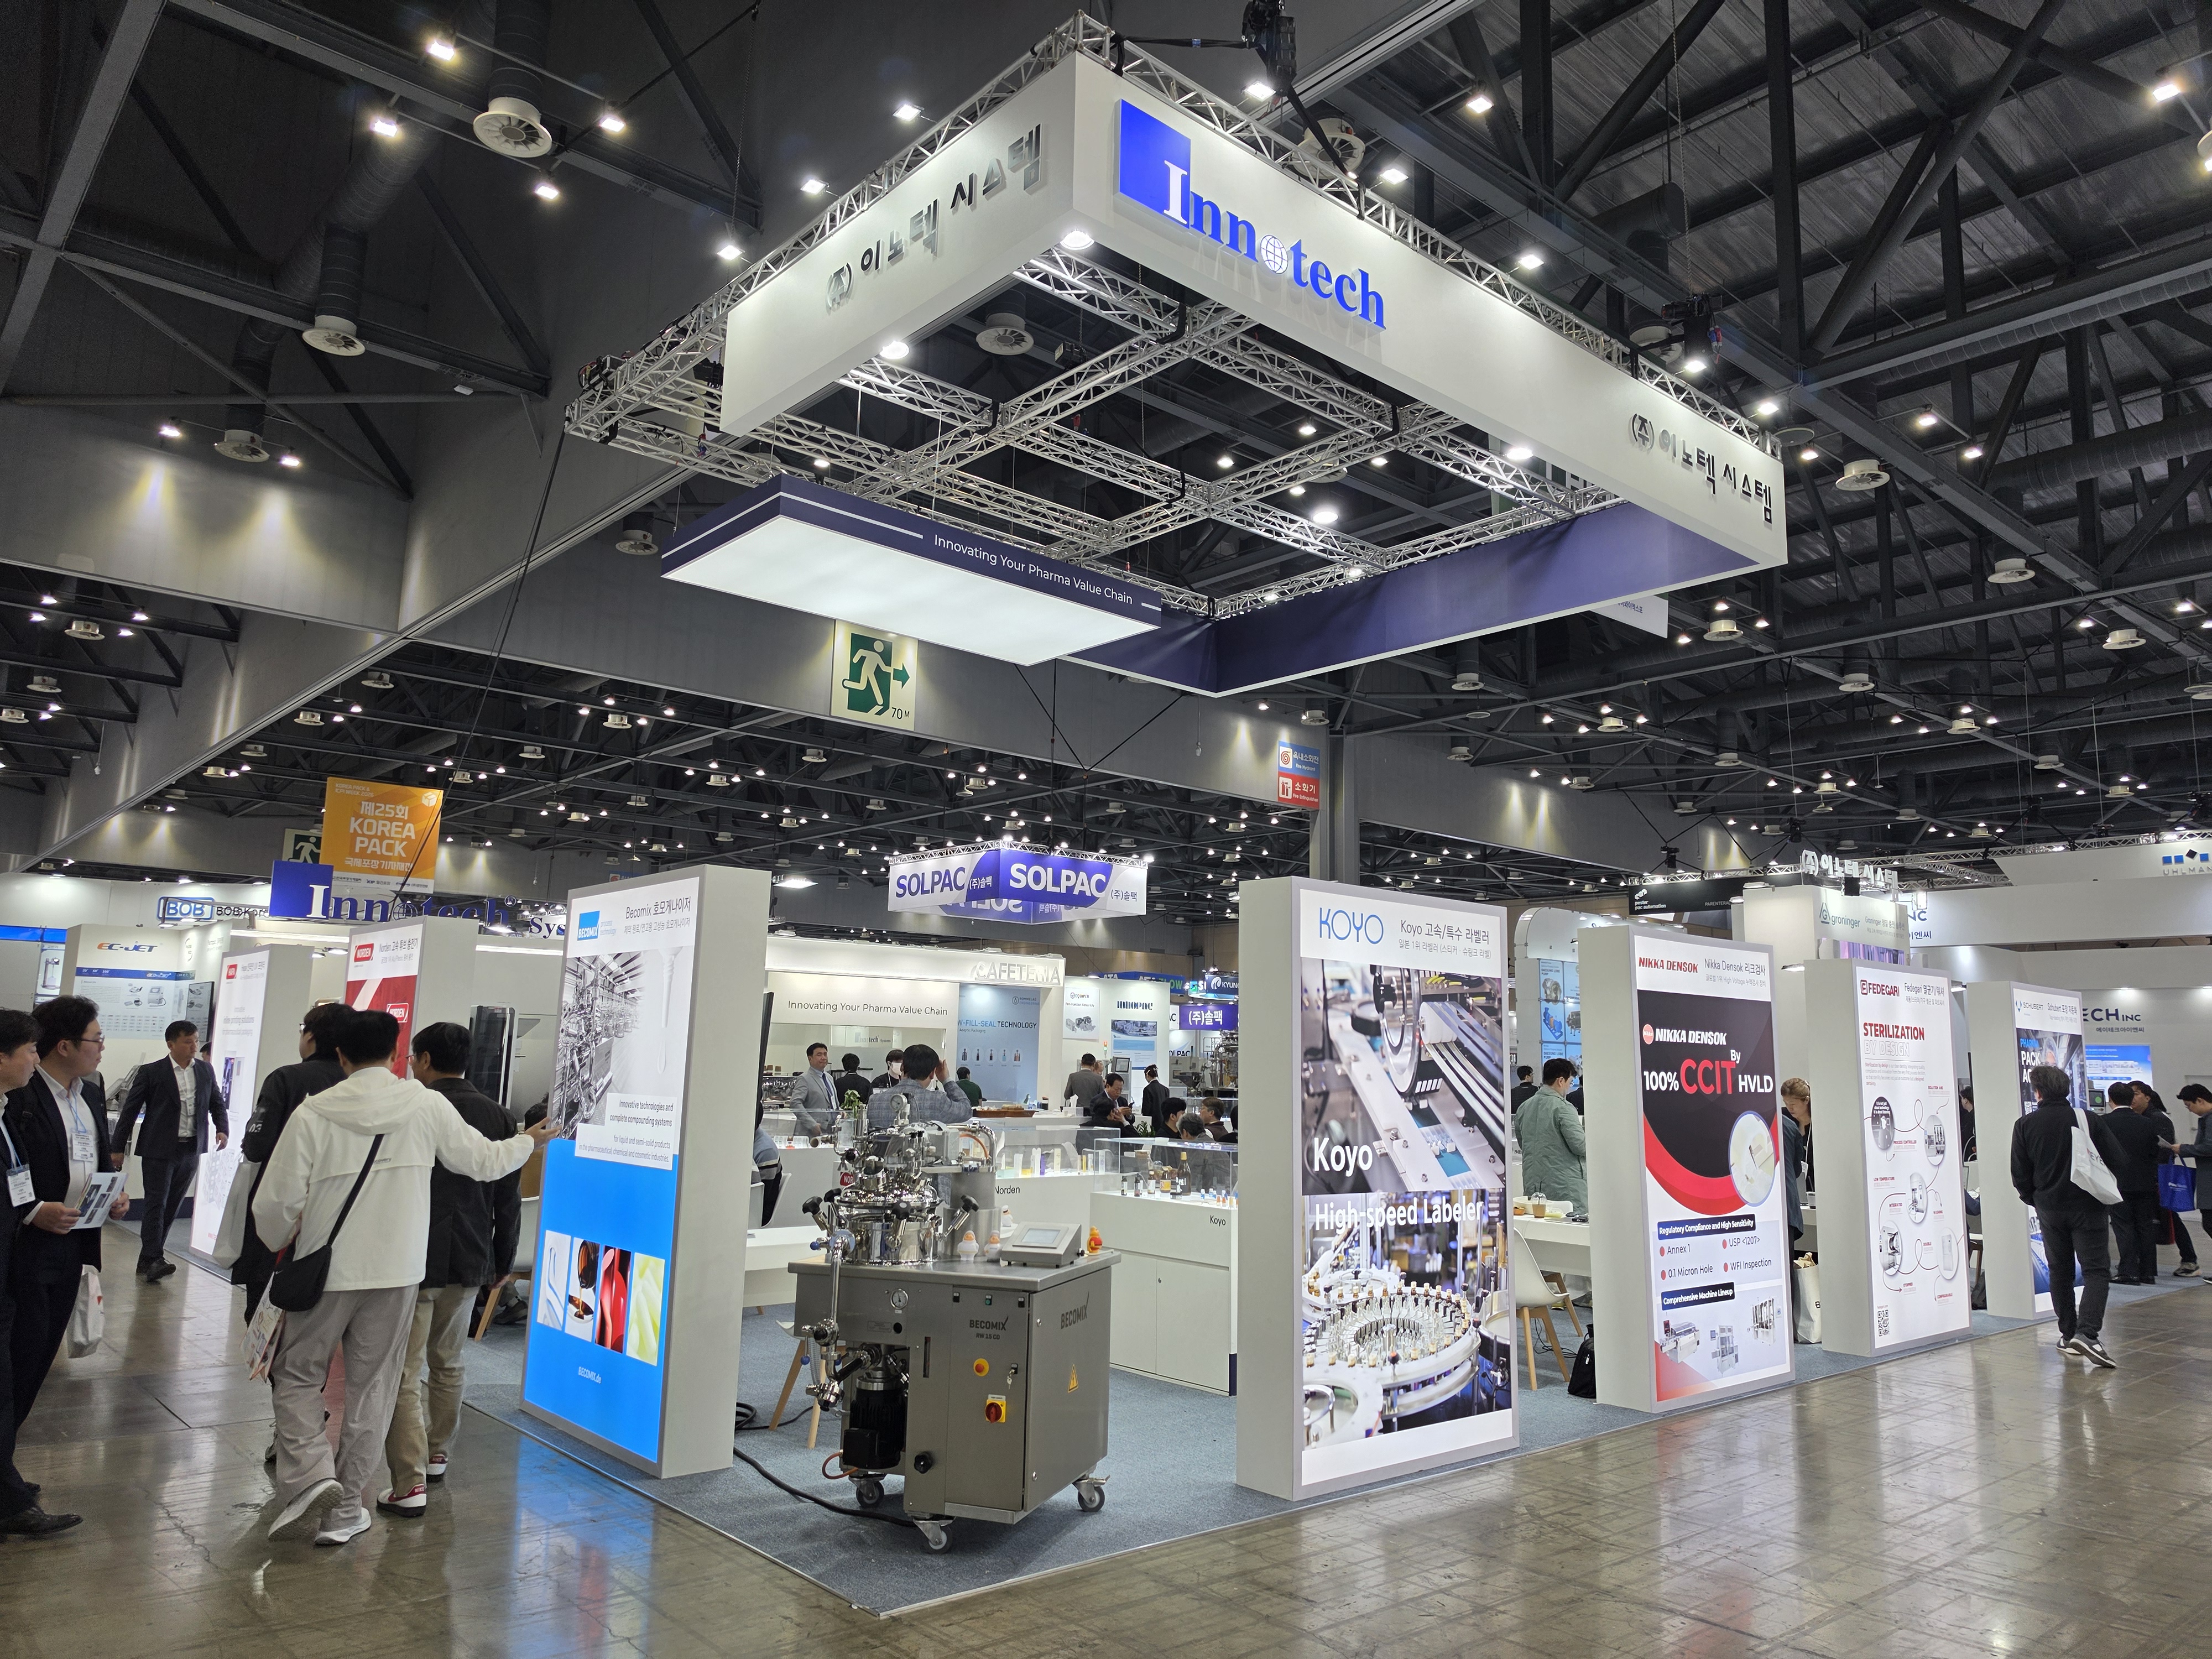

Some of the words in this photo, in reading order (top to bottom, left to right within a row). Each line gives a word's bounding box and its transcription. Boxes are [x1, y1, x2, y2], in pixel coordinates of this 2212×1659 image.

[950, 123, 1042, 209] 시스템
[1723, 464, 1772, 524] 시스템
[935, 534, 997, 566] Innovating
[1000, 556, 1025, 572] Your
[1029, 565, 1071, 586] Pharma
[1073, 578, 1101, 595] Value
[1104, 588, 1133, 604] Chain
[891, 707, 903, 719] 70
[1293, 752, 1318, 764] 옥내소화전
[1295, 782, 1315, 794] 소화기
[361, 801, 409, 820] 제25회
[349, 817, 415, 839] KOREA
[355, 837, 408, 857] PACK
[896, 866, 966, 898] SOLPAC
[969, 876, 993, 890] (주)솔팩
[1010, 864, 1105, 898] SOLPAC
[1110, 889, 1138, 902] (주)솔팩
[166, 901, 205, 916] BOB
[626, 904, 651, 919] Becomix
[653, 896, 691, 916] 호모게나이저
[624, 925, 631, 935] 제약
[632, 922, 652, 934] 원료/연고용
[654, 922, 664, 932] 고성능
[666, 917, 690, 930] 호모게나이저
[1319, 907, 1384, 945] KOYO
[1832, 915, 1860, 928] groninger
[1865, 916, 1881, 926] Groninger
[578, 926, 598, 938] BECOMIX
[1401, 920, 1422, 937] Koyo
[1425, 923, 1463, 941] 고속/특수
[1465, 928, 1490, 945] 라벨러
[357, 948, 371, 958] NORDEN
[1399, 939, 1410, 950] 일본
[1412, 941, 1421, 951] 1위
[1422, 942, 1438, 953] 라벨러
[1440, 943, 1457, 956] (스티커
[1463, 947, 1478, 957] 슈링크
[1480, 948, 1491, 959] 라벨)
[1639, 957, 1664, 970] NIKKA
[1667, 960, 1698, 973] DENSOK
[1704, 958, 1720, 970] Nikka
[1722, 961, 1743, 973] Densok
[1745, 963, 1766, 976] 리크검사
[975, 961, 1061, 985] CAFETERIA
[1705, 974, 1716, 983] 글로벌
[1732, 977, 1745, 986] Voltage
[1868, 983, 1900, 997] FEDEGARI
[1905, 983, 1922, 994] Fedegari
[788, 1000, 837, 1012] Innovating
[841, 1003, 860, 1011] Your
[863, 1004, 896, 1013] Pharma
[899, 1005, 922, 1014] Value
[925, 1007, 948, 1015] Chain
[2023, 1002, 2043, 1010] SCHUBERT
[2047, 1003, 2061, 1012] Schubert
[2062, 1005, 2068, 1014] 포장
[1188, 1010, 1223, 1025] (주)솔팩
[1655, 1028, 1686, 1043] NIKKA
[1688, 1030, 1727, 1045] DENSOK
[1864, 1022, 1924, 1040] STERILIZATION
[1864, 1040, 1876, 1055] BY
[1879, 1041, 1910, 1057] DESIGN
[1730, 1050, 1741, 1064] By
[2021, 1051, 2041, 1066] PACK
[1644, 1071, 1679, 1091] 100%
[1680, 1058, 1736, 1094] CCIT
[1738, 1074, 1773, 1093] HVLD
[619, 1099, 639, 1109] Innovative
[640, 1101, 664, 1113] technologies
[610, 1114, 627, 1124] complete
[628, 1115, 654, 1127] compounding
[655, 1119, 672, 1128] systems
[619, 1135, 628, 1145] liquid
[636, 1138, 654, 1147] semi-solid
[654, 1140, 670, 1149] products
[588, 1144, 612, 1155] pharmaceutical,
[613, 1146, 628, 1156] chemical
[635, 1150, 650, 1160] cosmetic
[651, 1151, 669, 1162] industries.
[1313, 1137, 1373, 1177] Koyo
[1210, 1215, 1226, 1227] Koyo
[1315, 1198, 1418, 1235] High-speed
[1423, 1195, 1483, 1225] Labeler
[1660, 1225, 1684, 1235] Regulatory
[1685, 1223, 1711, 1232] Compliance
[1721, 1220, 1731, 1229] High
[1732, 1219, 1754, 1228] Sensitivity
[1729, 1238, 1740, 1246] USP
[1743, 1236, 1760, 1245] <1207>
[1667, 1245, 1687, 1255] Annex
[1688, 1244, 1691, 1252] 1
[1678, 1267, 1698, 1277] Micron
[1699, 1264, 1713, 1274] Hole
[1730, 1261, 1741, 1271] WFI
[1743, 1258, 1772, 1270] Inspection
[1663, 1293, 1698, 1305] Comprehensive
[1699, 1290, 1717, 1299] Machine
[1718, 1288, 1733, 1297] Lineup
[1061, 1291, 1089, 1329] BECOMIX
[969, 1316, 1009, 1331] BECOMIX
[578, 1366, 602, 1385] BECOMIX.de
